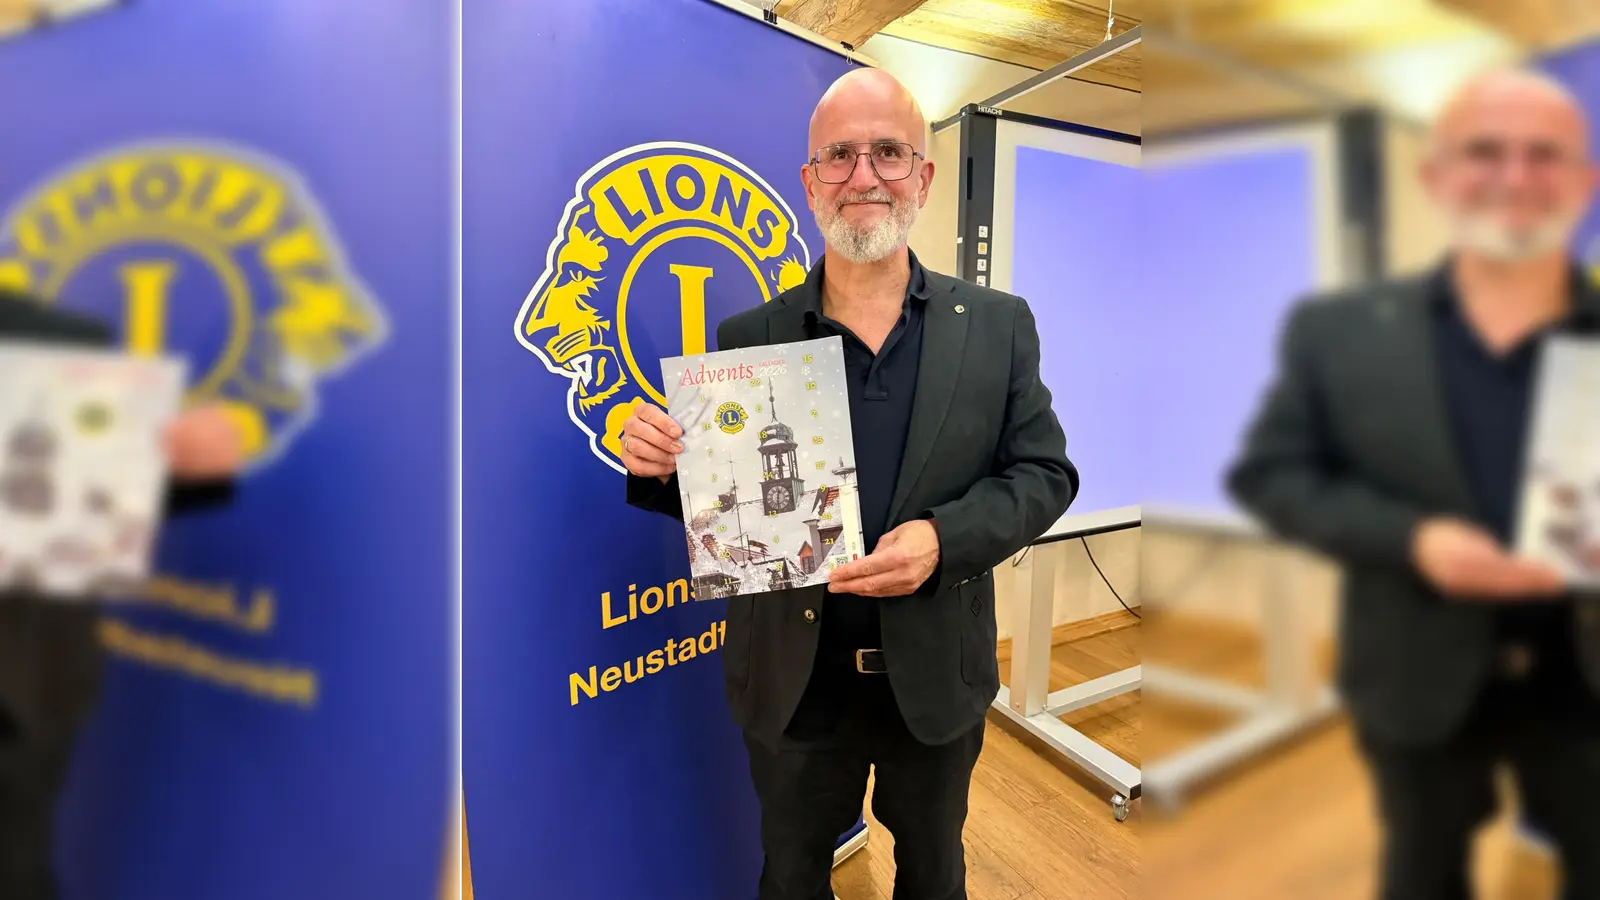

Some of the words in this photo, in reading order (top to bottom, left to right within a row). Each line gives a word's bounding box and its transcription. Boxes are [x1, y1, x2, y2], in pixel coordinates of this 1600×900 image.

[978, 105, 1003, 116] HITACHI
[603, 163, 780, 249] LIONS
[803, 355, 813, 364] 15
[680, 362, 754, 387] Advents
[760, 365, 787, 377] 2026
[805, 381, 817, 390] 10
[719, 403, 740, 411] LIONS
[727, 412, 737, 424] L
[758, 431, 768, 439] 18
[820, 484, 827, 493] 9
[768, 510, 777, 518] 13
[724, 577, 732, 585] 11
